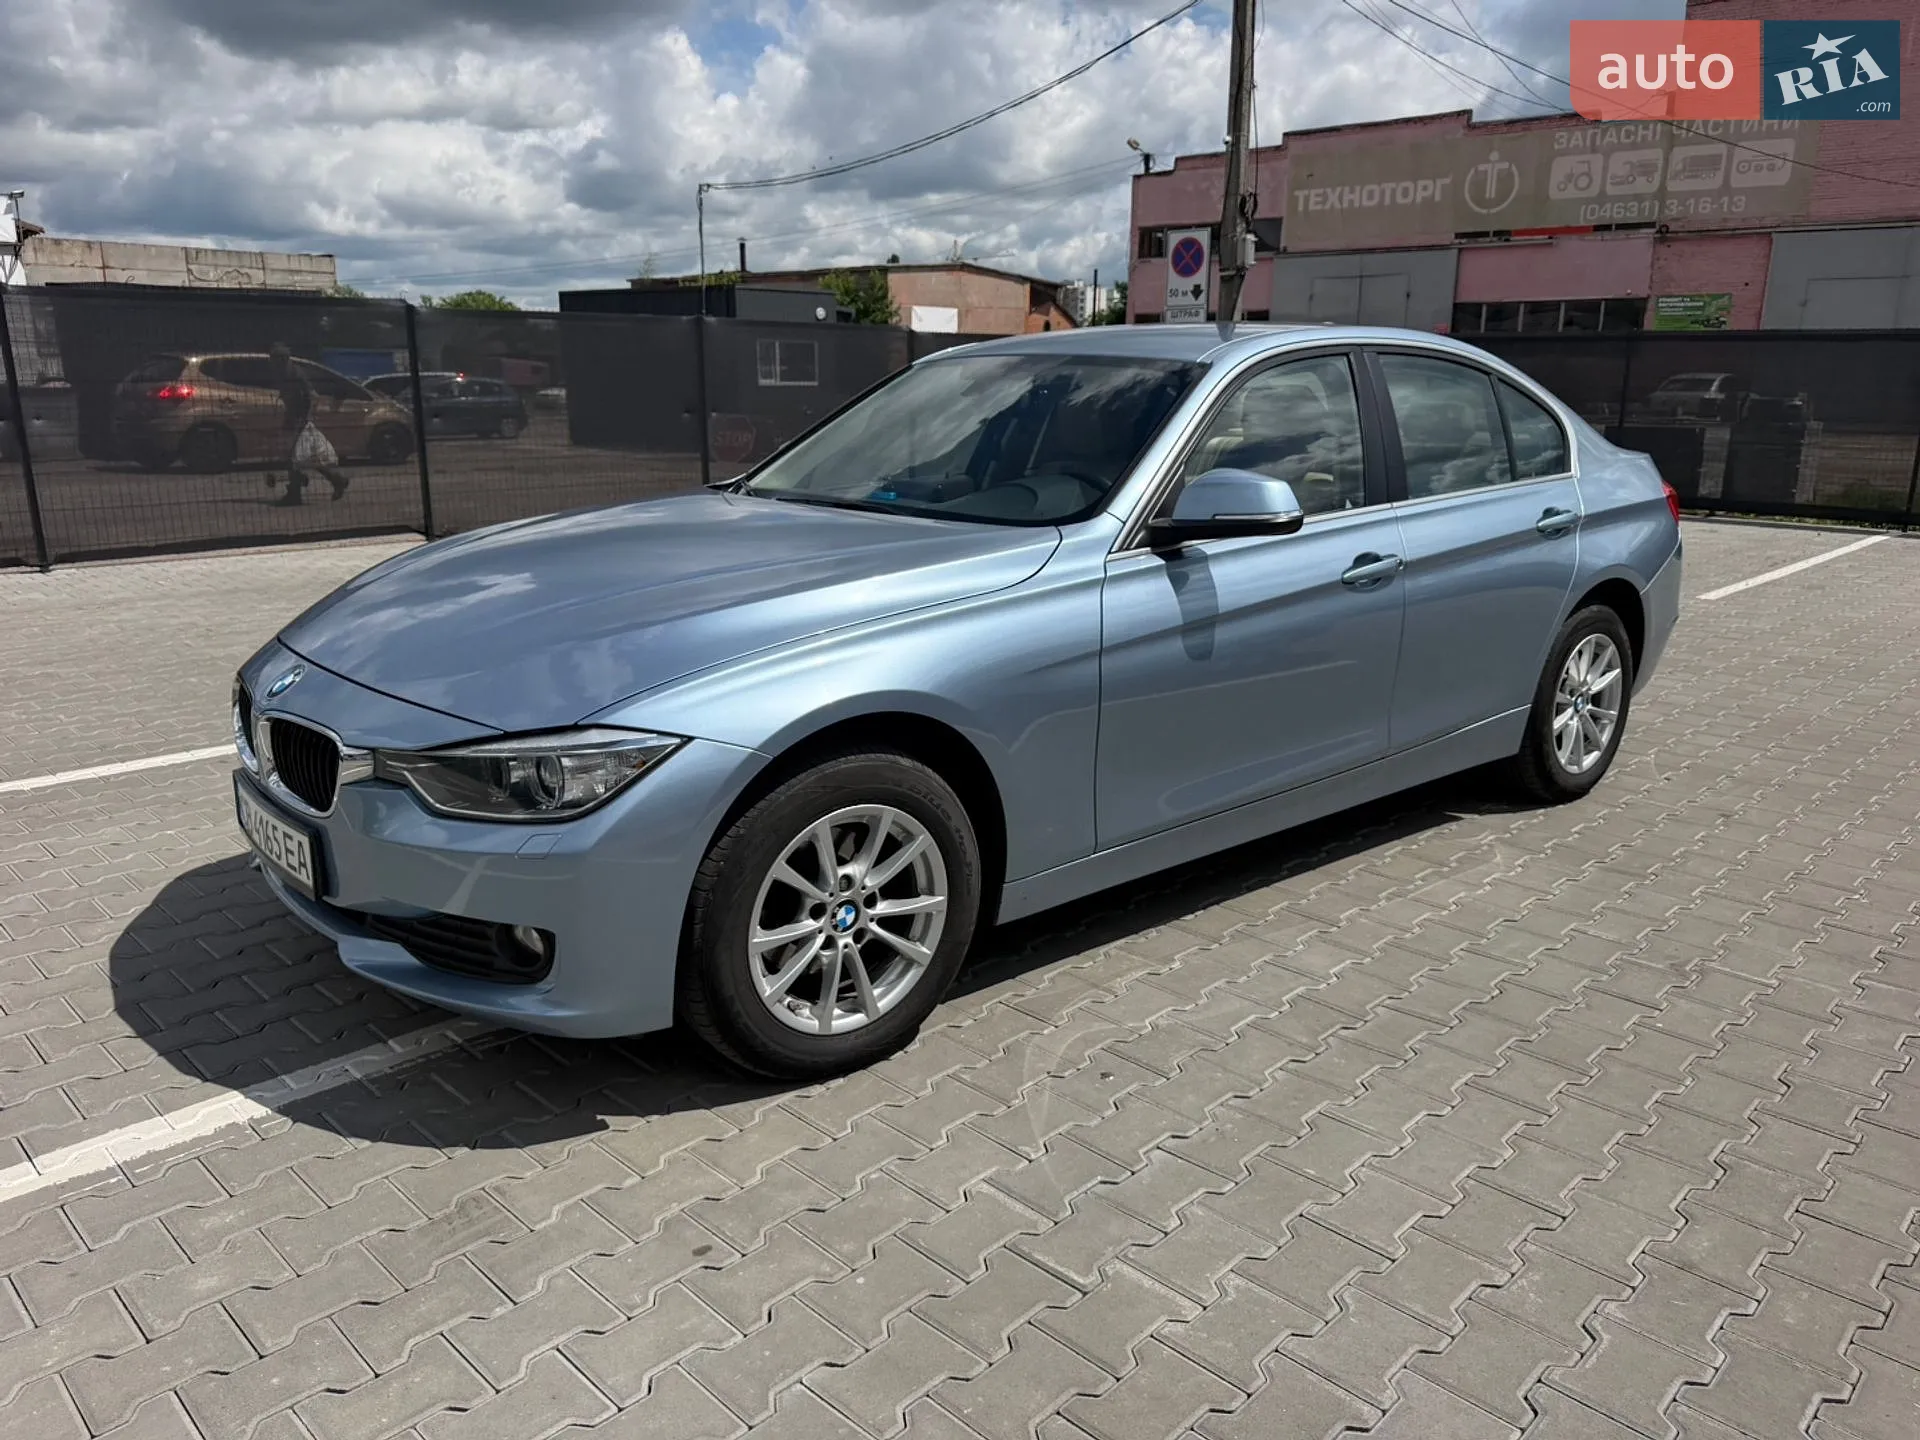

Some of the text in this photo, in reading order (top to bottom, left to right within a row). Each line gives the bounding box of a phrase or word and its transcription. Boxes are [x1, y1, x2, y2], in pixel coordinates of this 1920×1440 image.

[1553, 123, 1661, 149] ЗАПАСНІ
[1294, 175, 1452, 212] ТЕХНОТОРГ
[1580, 196, 1746, 221] (04631) 3-16-13
[1168, 288, 1179, 298] 50
